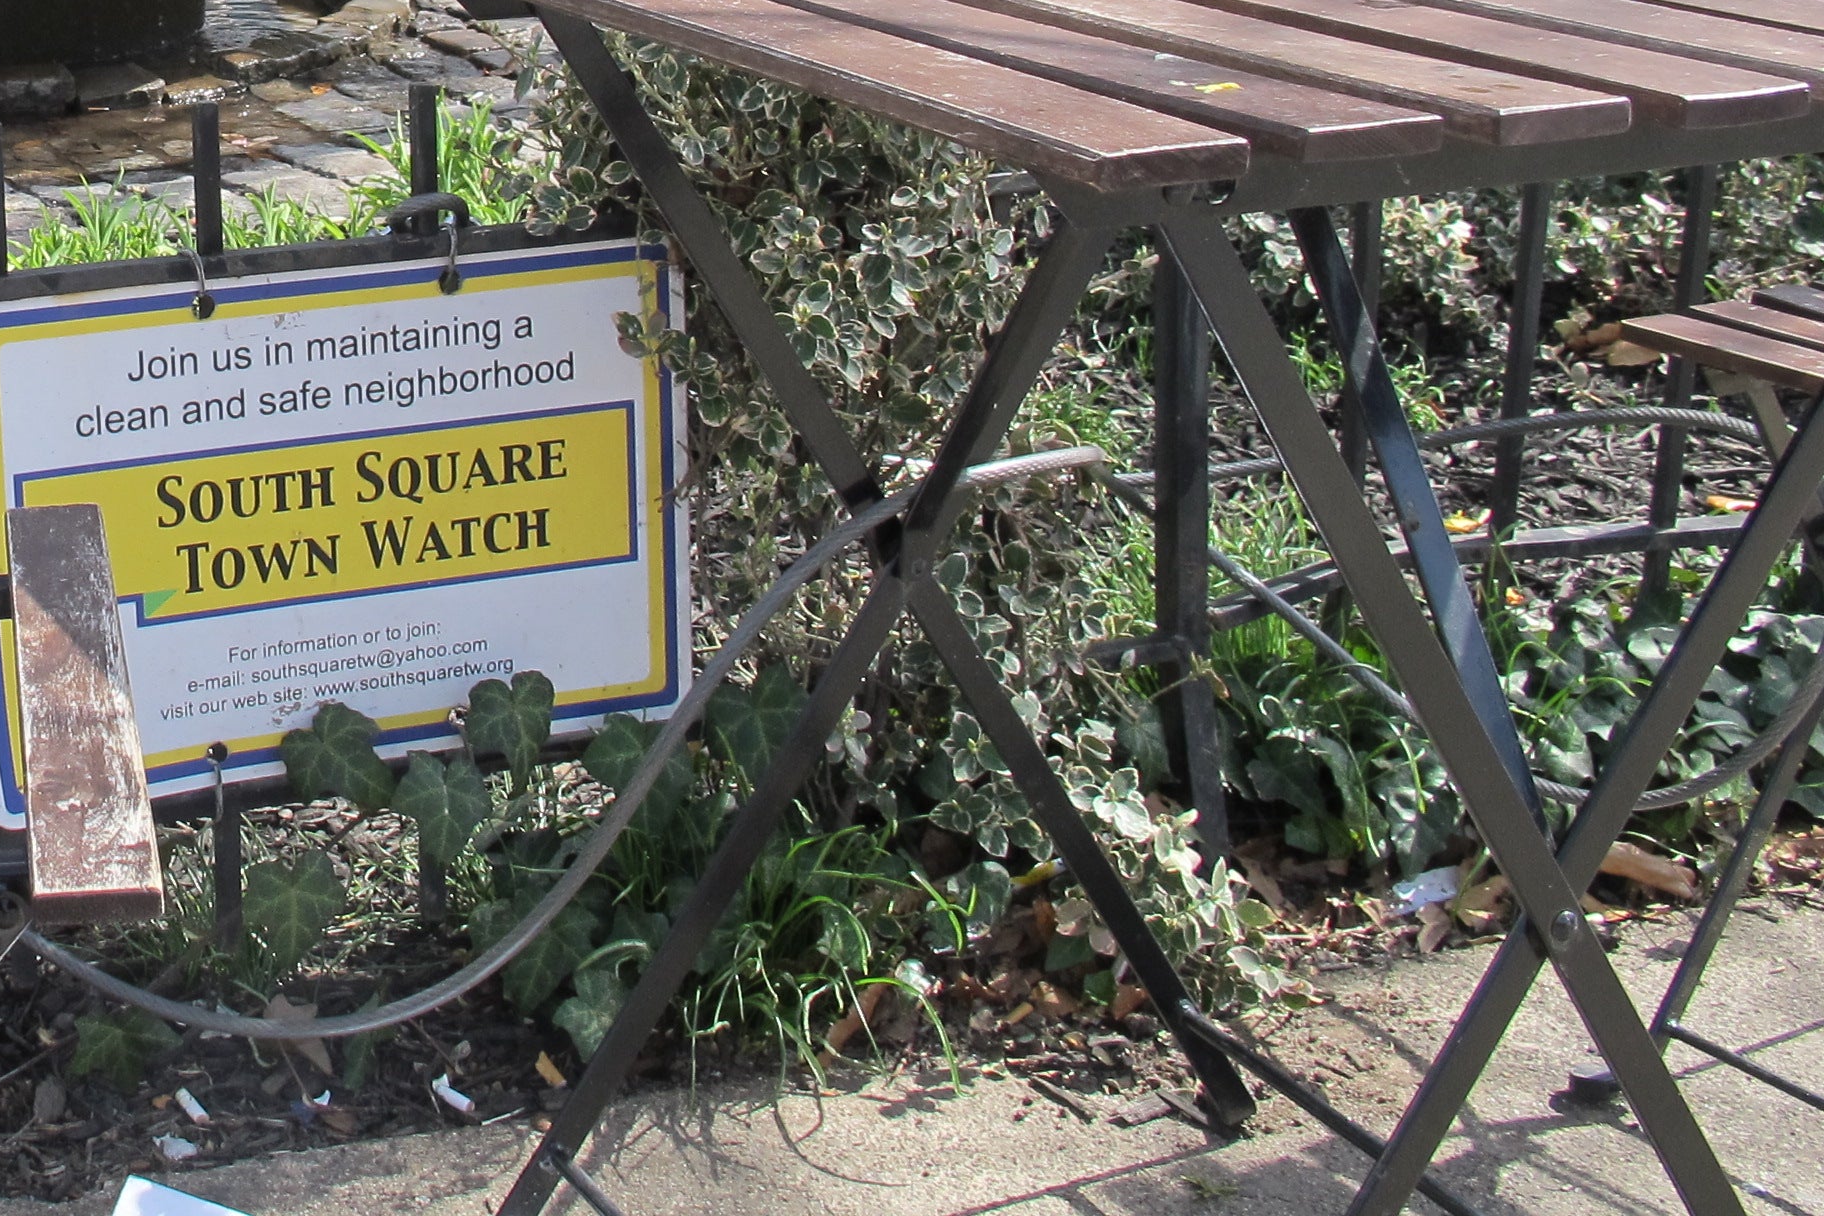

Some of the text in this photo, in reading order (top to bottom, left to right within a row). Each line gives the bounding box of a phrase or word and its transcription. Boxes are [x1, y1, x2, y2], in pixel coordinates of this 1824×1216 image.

[127, 314, 534, 383] Join us in maintaining a
[75, 351, 576, 438] clean and safe neighborhood
[156, 438, 568, 529] SOUTH SQUARE
[176, 508, 552, 594] TOWN WATCH
[187, 636, 489, 694] e-mail: southsquaretw@yahoo.com
[229, 620, 442, 664] For information or to join:
[160, 656, 515, 721] visit our web site: www.southsquaretw.org
